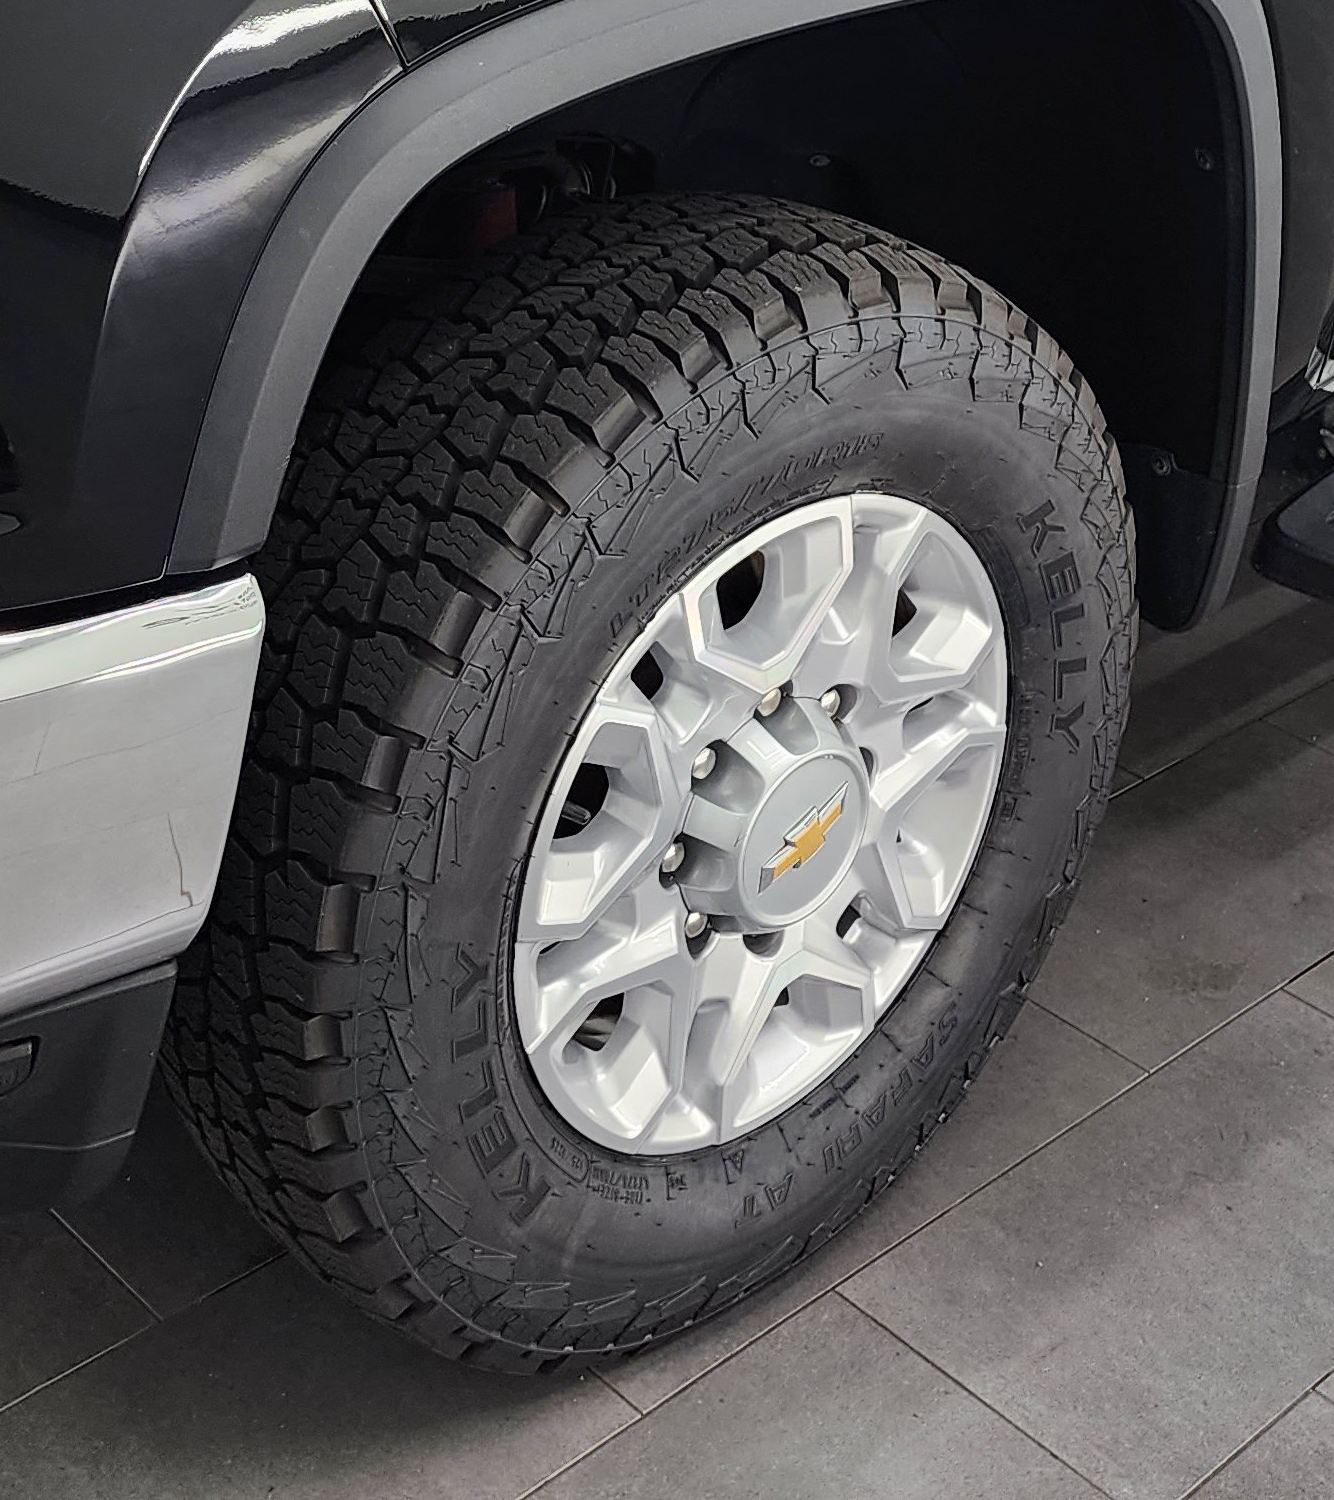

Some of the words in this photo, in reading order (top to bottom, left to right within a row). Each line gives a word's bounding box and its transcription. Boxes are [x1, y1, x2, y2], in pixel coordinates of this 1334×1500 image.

[1016, 499, 1087, 754] KELLY
[451, 942, 552, 1227] KELLY
[821, 1001, 958, 1174] SAFARI
